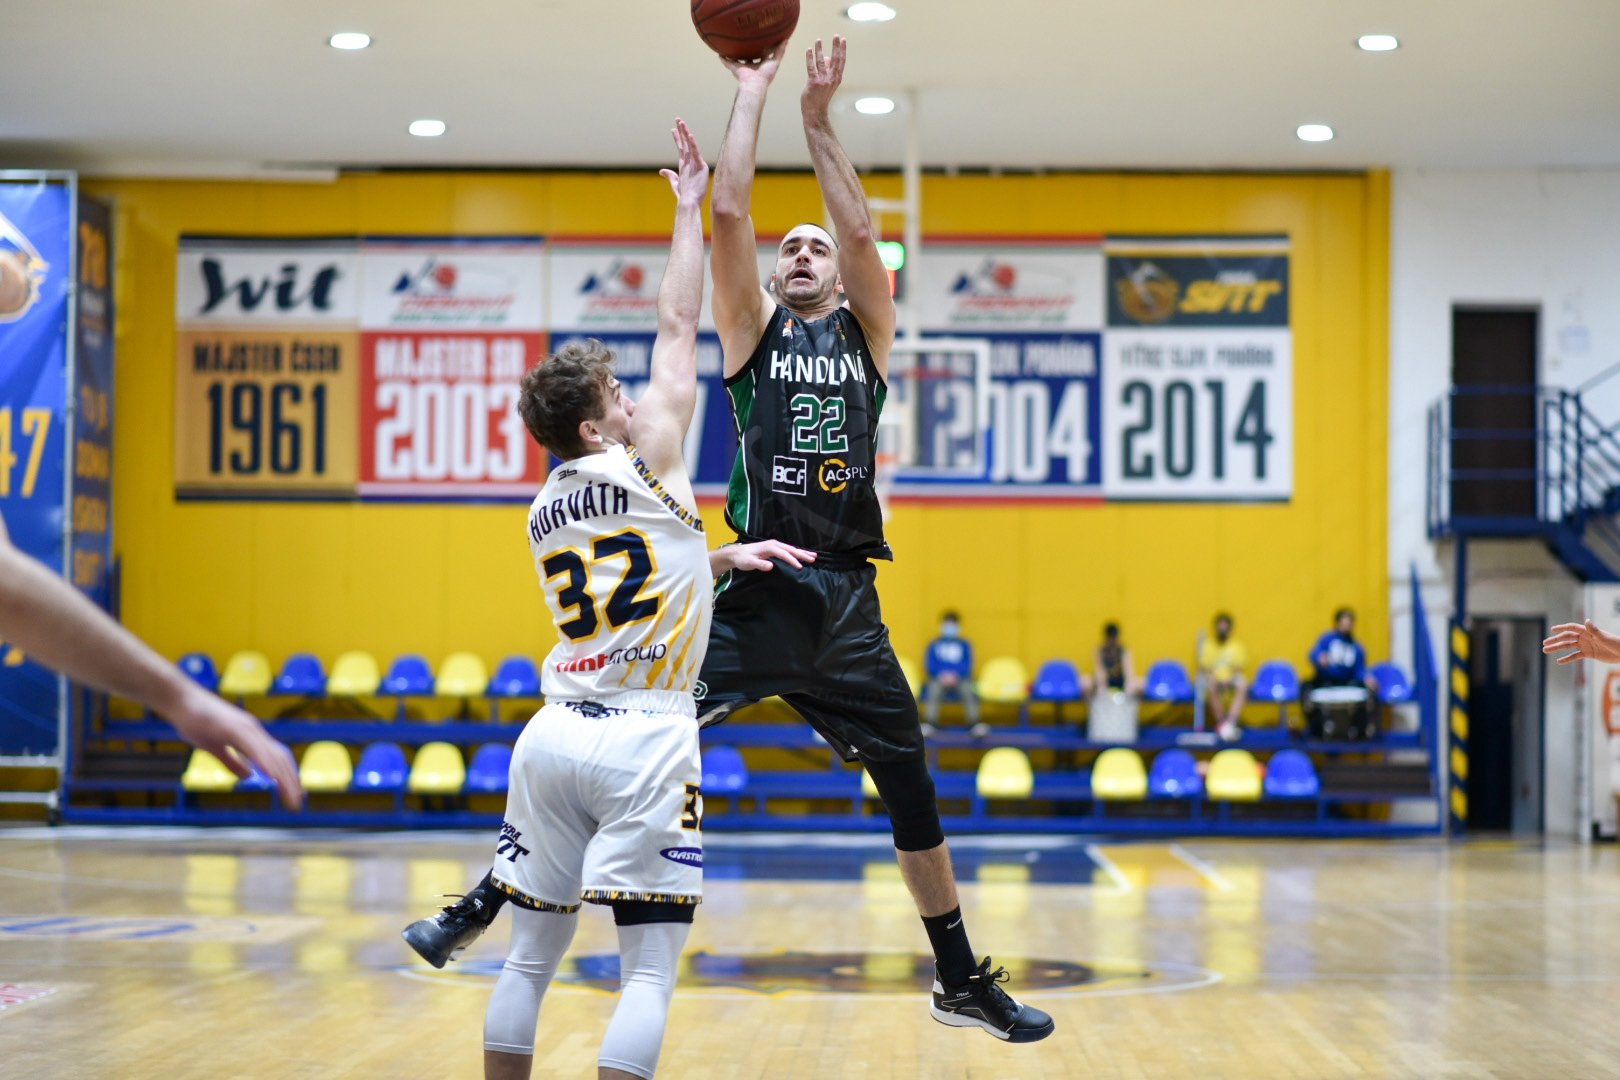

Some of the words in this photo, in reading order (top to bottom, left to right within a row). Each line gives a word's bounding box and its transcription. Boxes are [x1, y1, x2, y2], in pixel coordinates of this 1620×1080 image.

[208, 383, 326, 475] 1961
[375, 383, 527, 481] 2003
[790, 393, 848, 454] 22
[1121, 379, 1275, 480] 2014
[530, 481, 629, 544] HORVÁTH
[539, 525, 665, 644] 32
